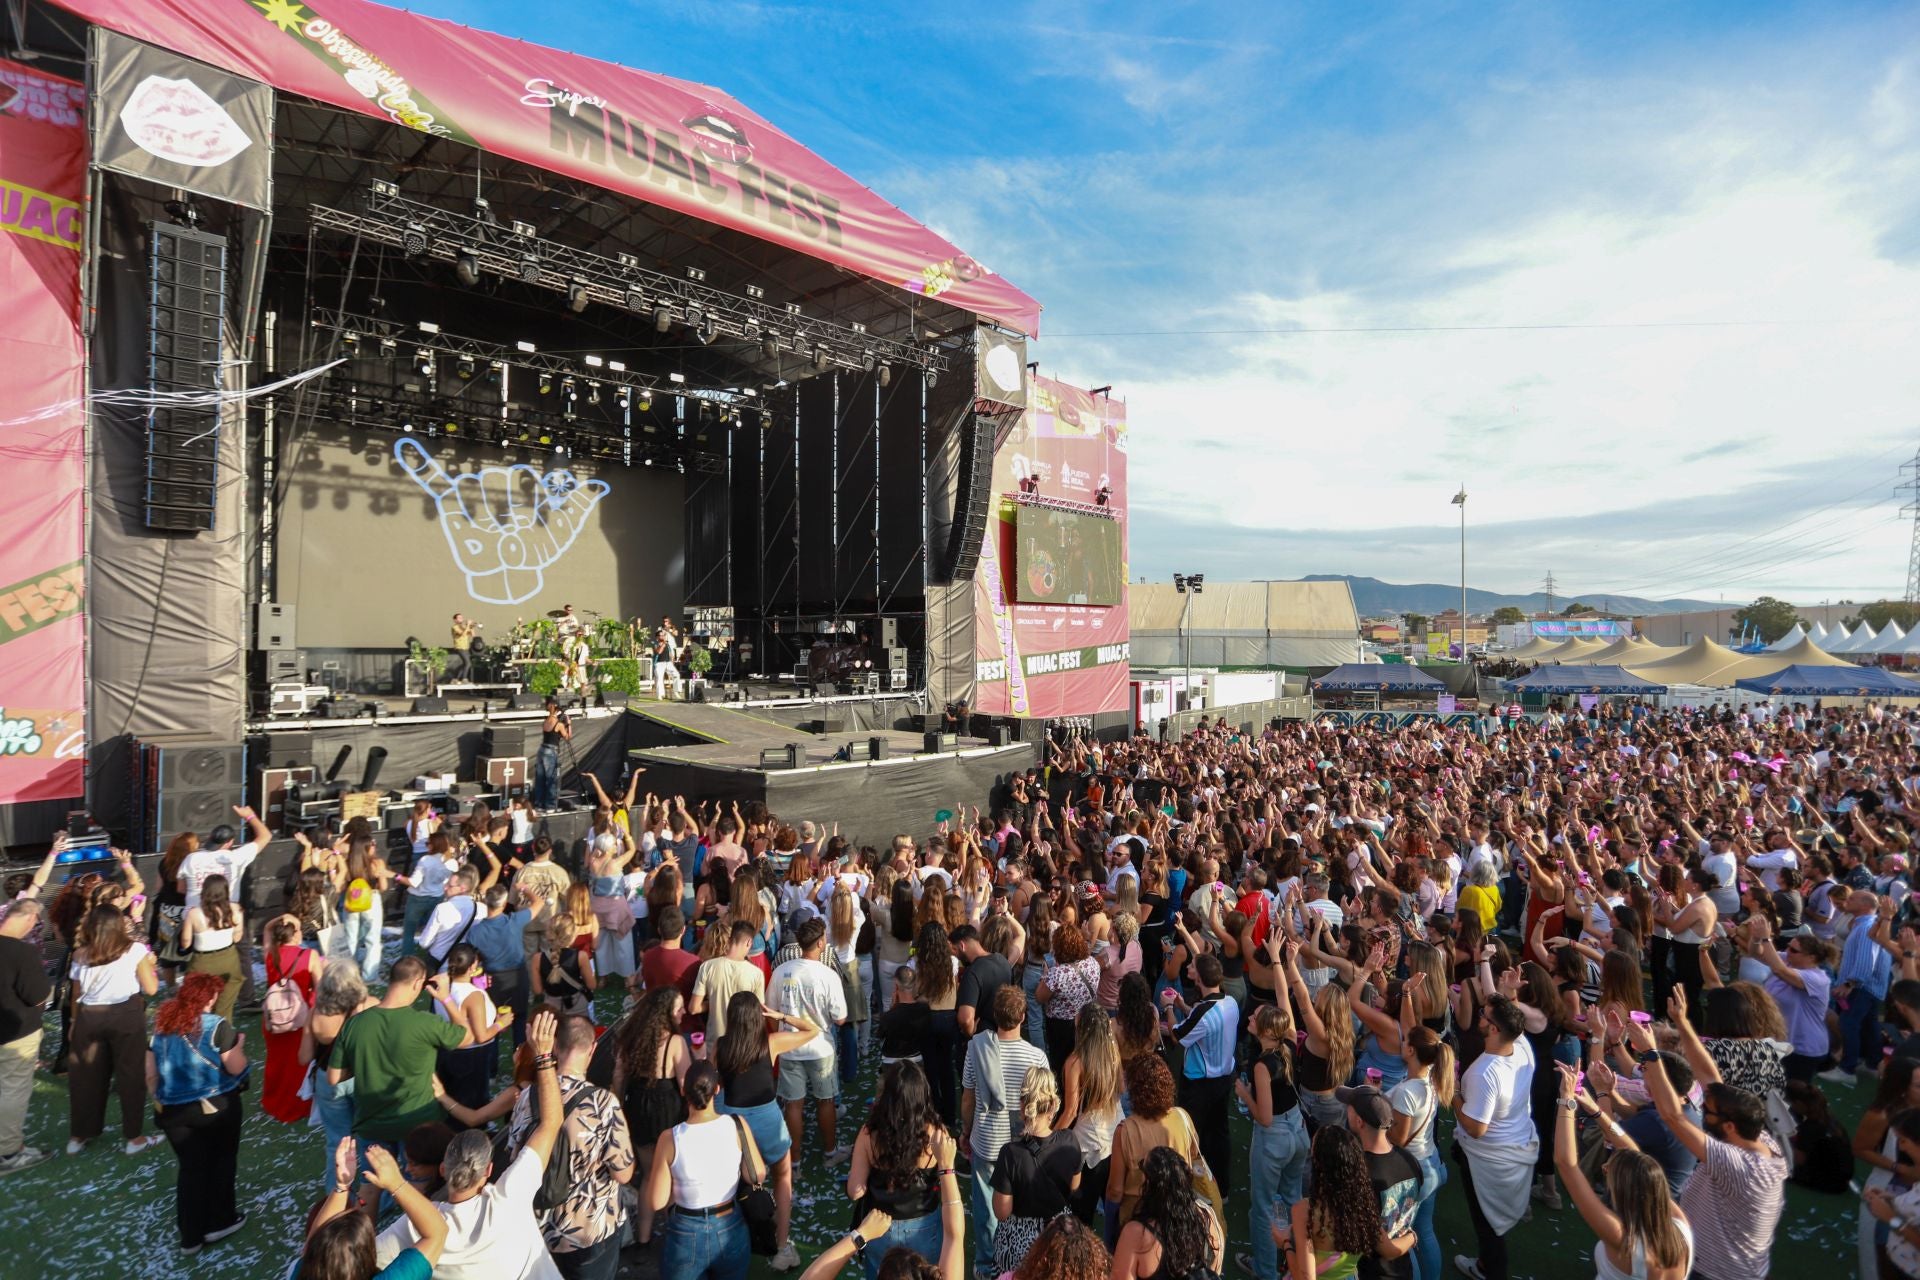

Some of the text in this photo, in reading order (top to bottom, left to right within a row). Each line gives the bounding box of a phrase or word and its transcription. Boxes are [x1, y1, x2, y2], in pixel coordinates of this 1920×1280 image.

[547, 84, 842, 248] MUAC FEST
[976, 660, 1005, 681] FEST
[1027, 654, 1058, 675] MUAC
[1059, 650, 1081, 670] FEST
[1097, 644, 1121, 665] MUAC
